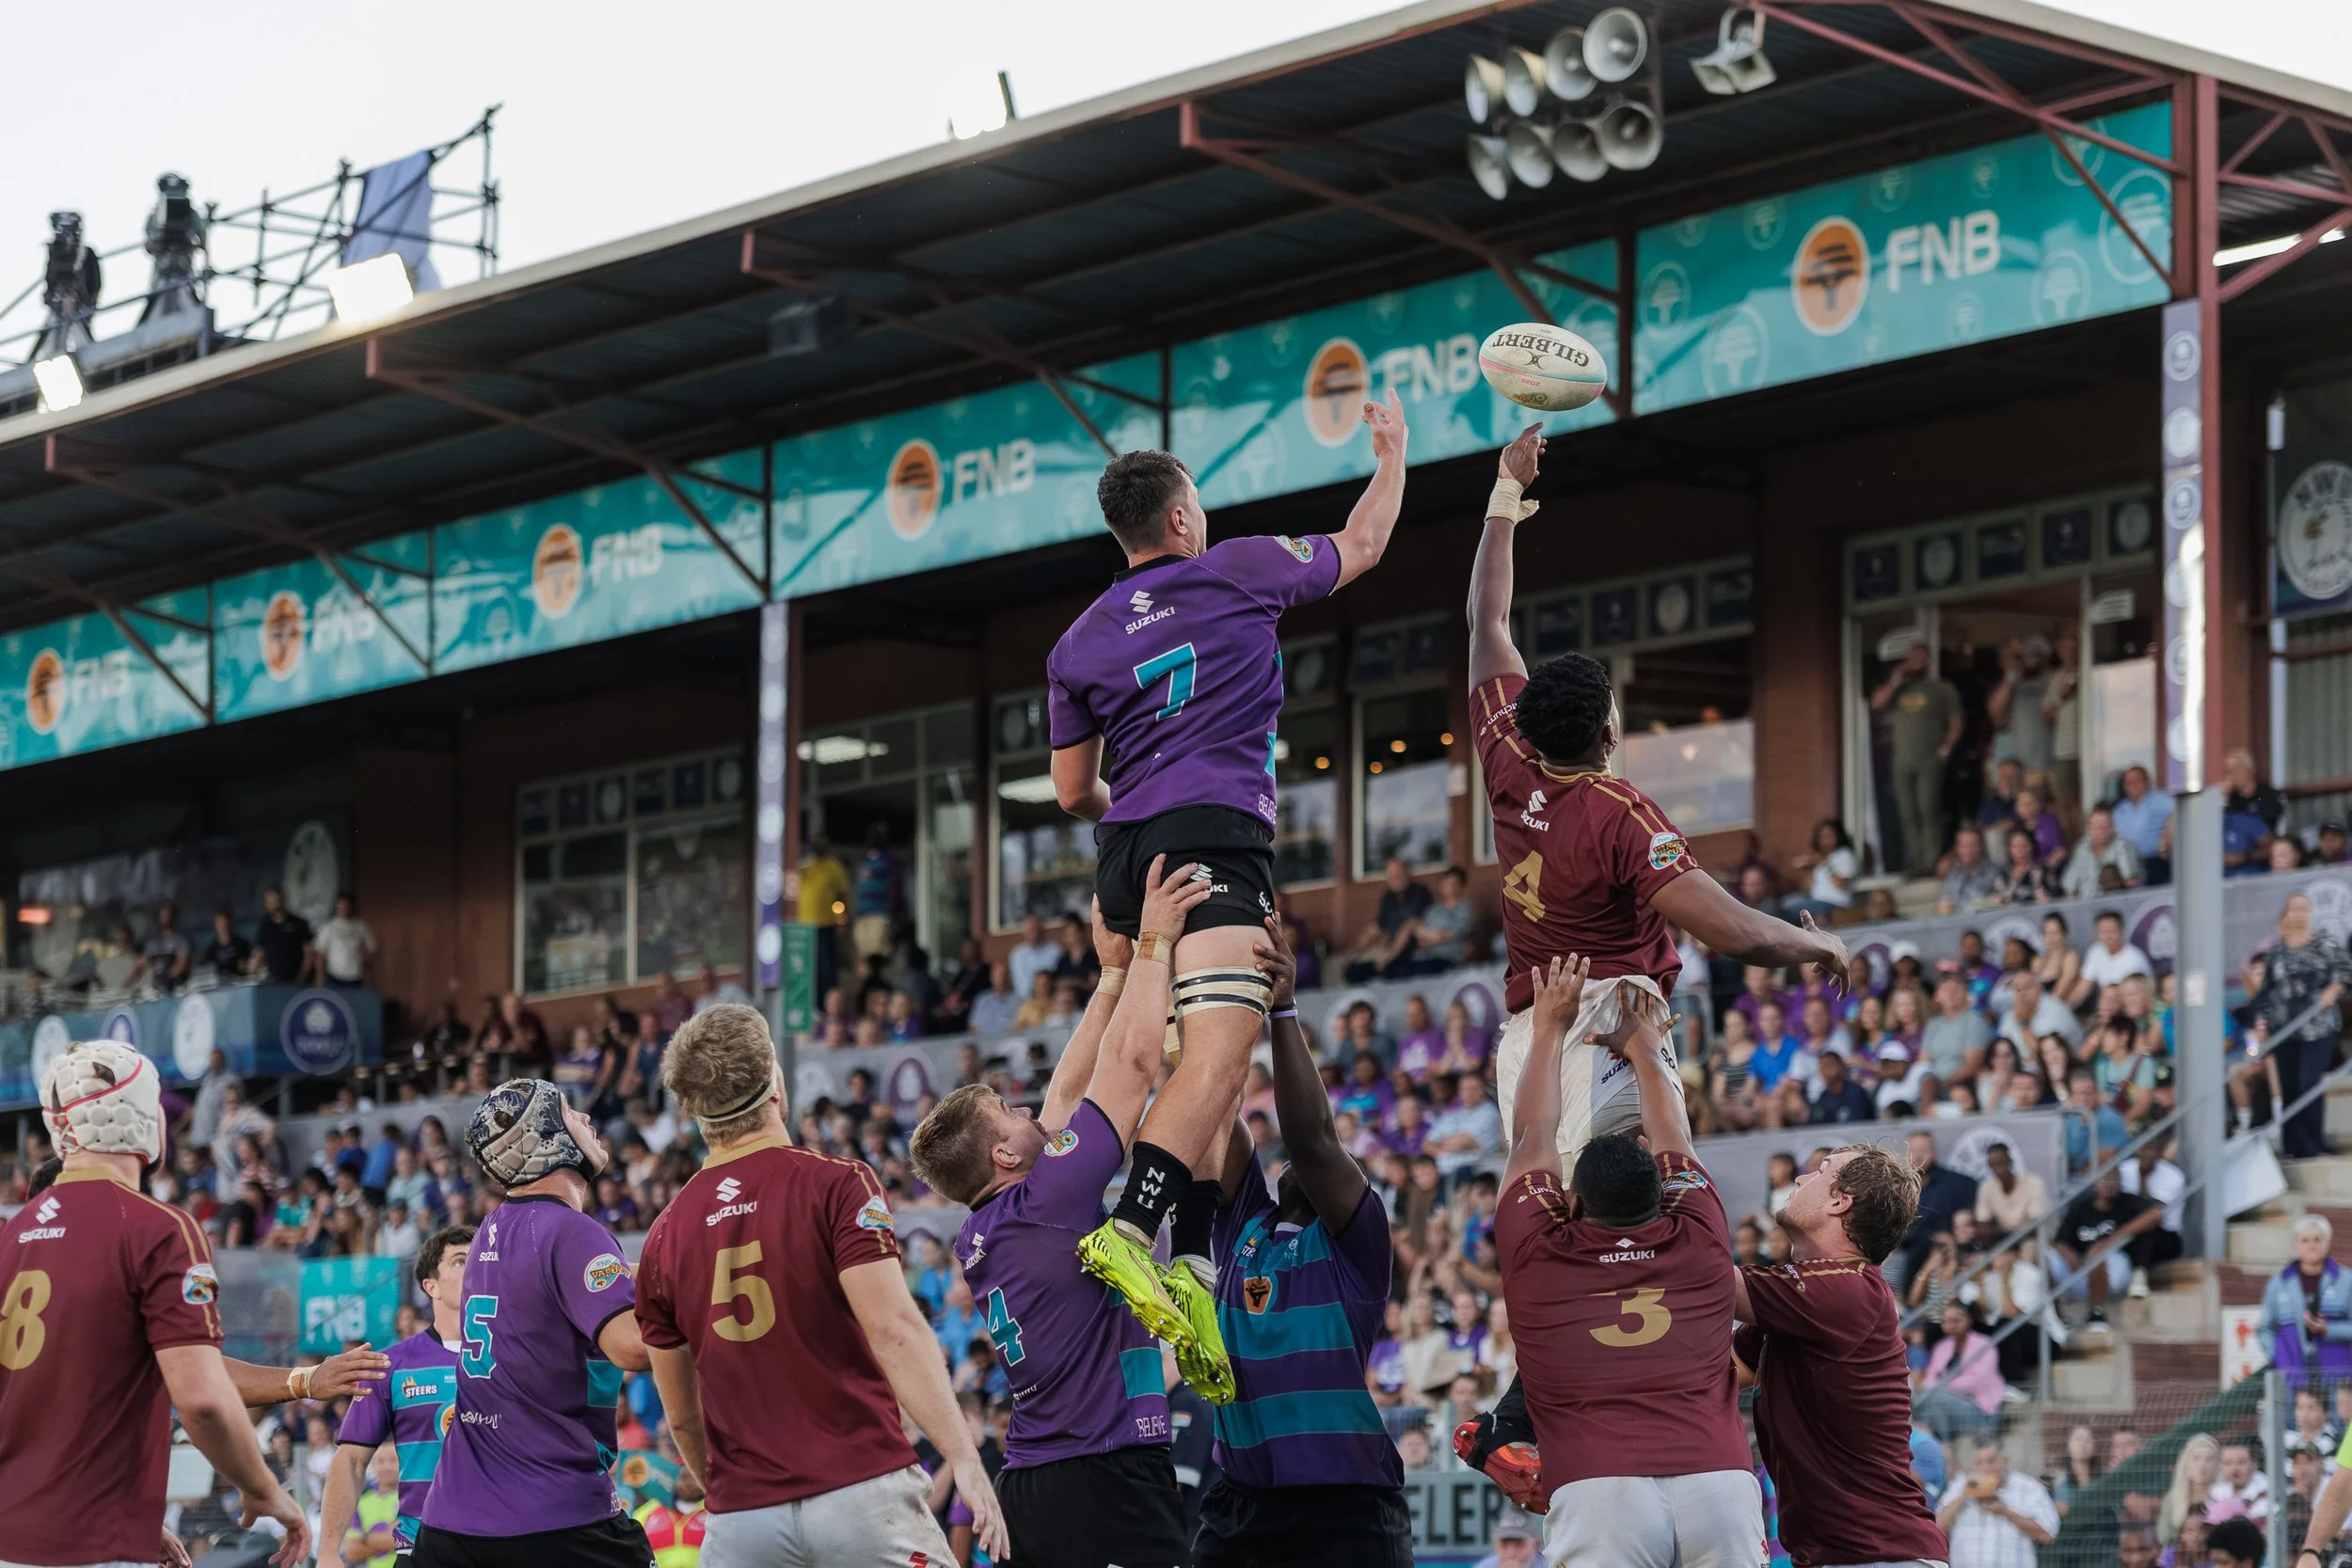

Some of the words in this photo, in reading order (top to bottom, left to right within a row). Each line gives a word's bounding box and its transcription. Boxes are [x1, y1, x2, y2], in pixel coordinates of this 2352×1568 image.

[1886, 209, 2000, 293] FNB
[1384, 334, 1479, 404] FNB
[1492, 333, 1590, 367] GILBERT
[953, 438, 1034, 501] FNB
[591, 523, 662, 585] FNB
[1125, 607, 1175, 634] SUZUKI
[1133, 642, 1197, 722] 7
[1502, 850, 1546, 923] 4
[1601, 1058, 1629, 1084] SUZU
[18, 1227, 66, 1243] SUZUKI
[707, 1201, 757, 1227] SUZUKI
[1599, 1249, 1656, 1263] SUZUKI
[0, 1270, 51, 1370] 8
[306, 1295, 367, 1344] FNB
[711, 1241, 776, 1342] 5
[1588, 1287, 1672, 1347] 3
[462, 1295, 499, 1379] 5
[988, 1287, 1025, 1367] 4
[405, 1385, 437, 1398] STEERS
